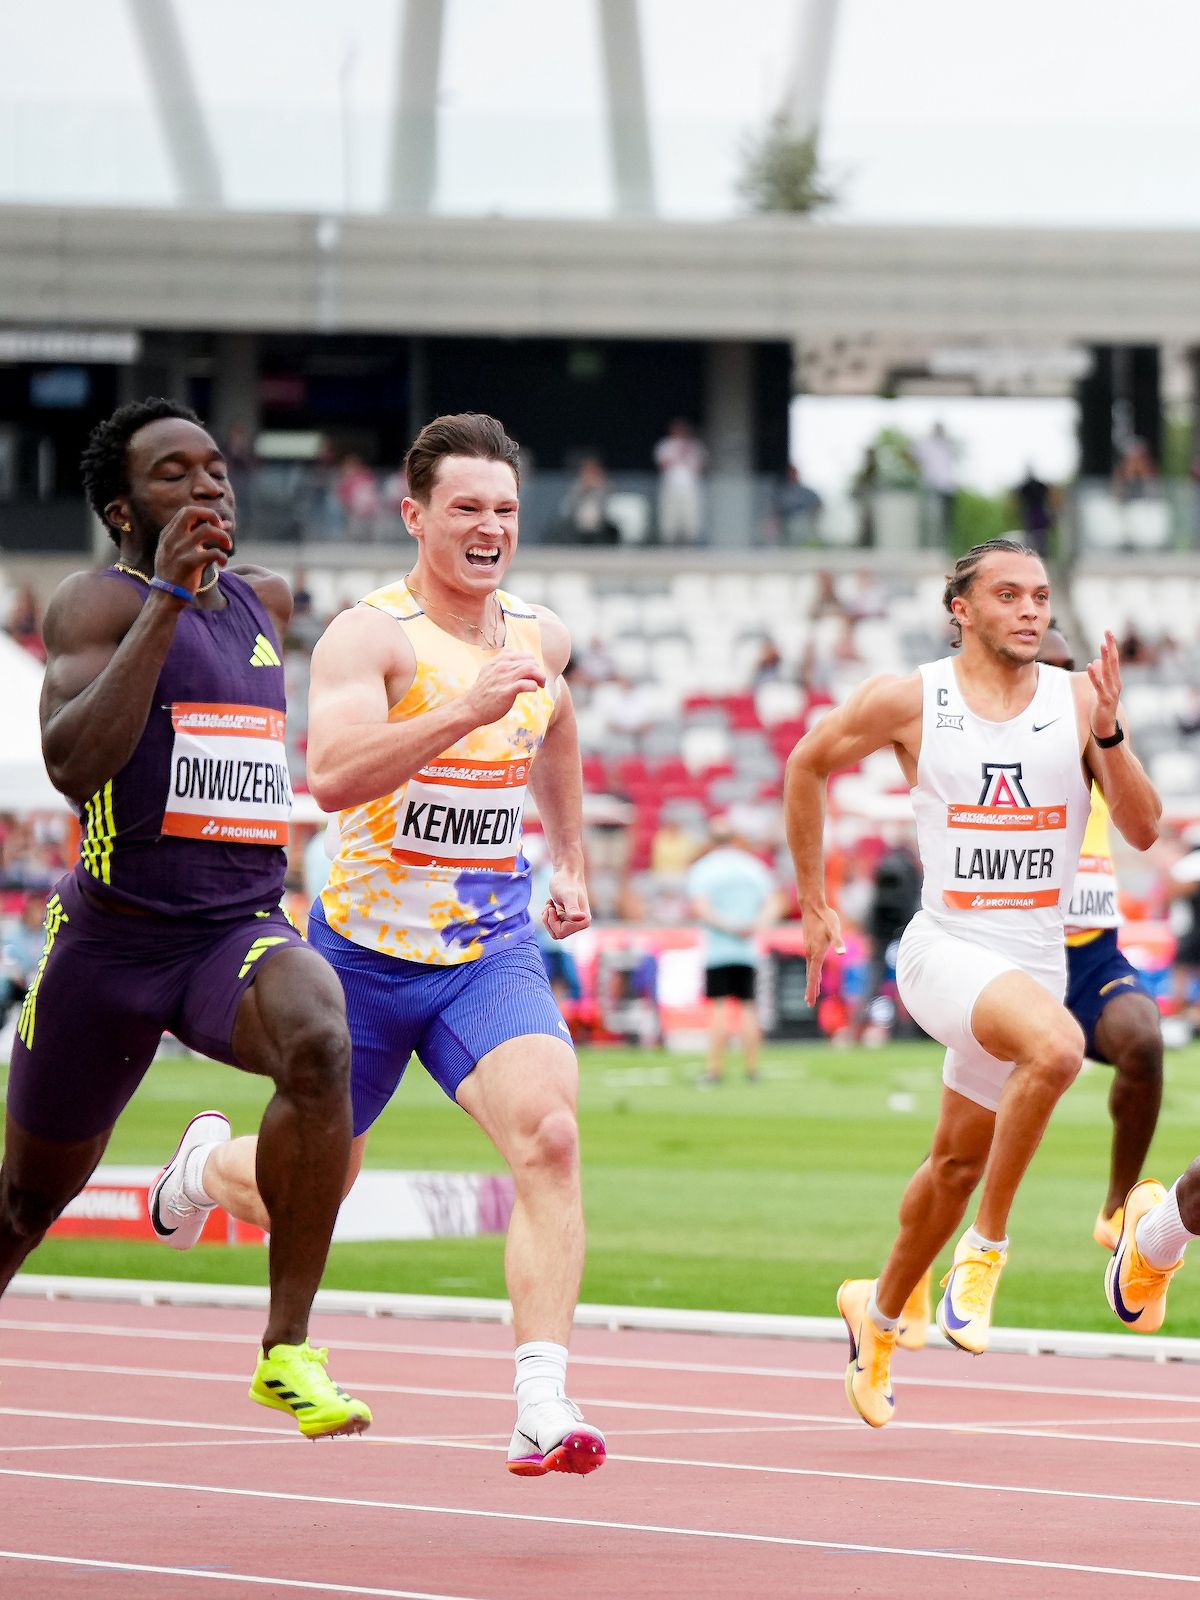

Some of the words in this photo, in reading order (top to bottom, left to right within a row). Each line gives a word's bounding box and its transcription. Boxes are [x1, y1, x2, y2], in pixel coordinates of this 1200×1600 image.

[937, 688, 948, 706] C
[402, 800, 520, 845] KENNEDY
[221, 826, 277, 839] PROHUMAN
[954, 846, 1054, 880] LAWYER
[985, 898, 1034, 907] PROHUMAN
